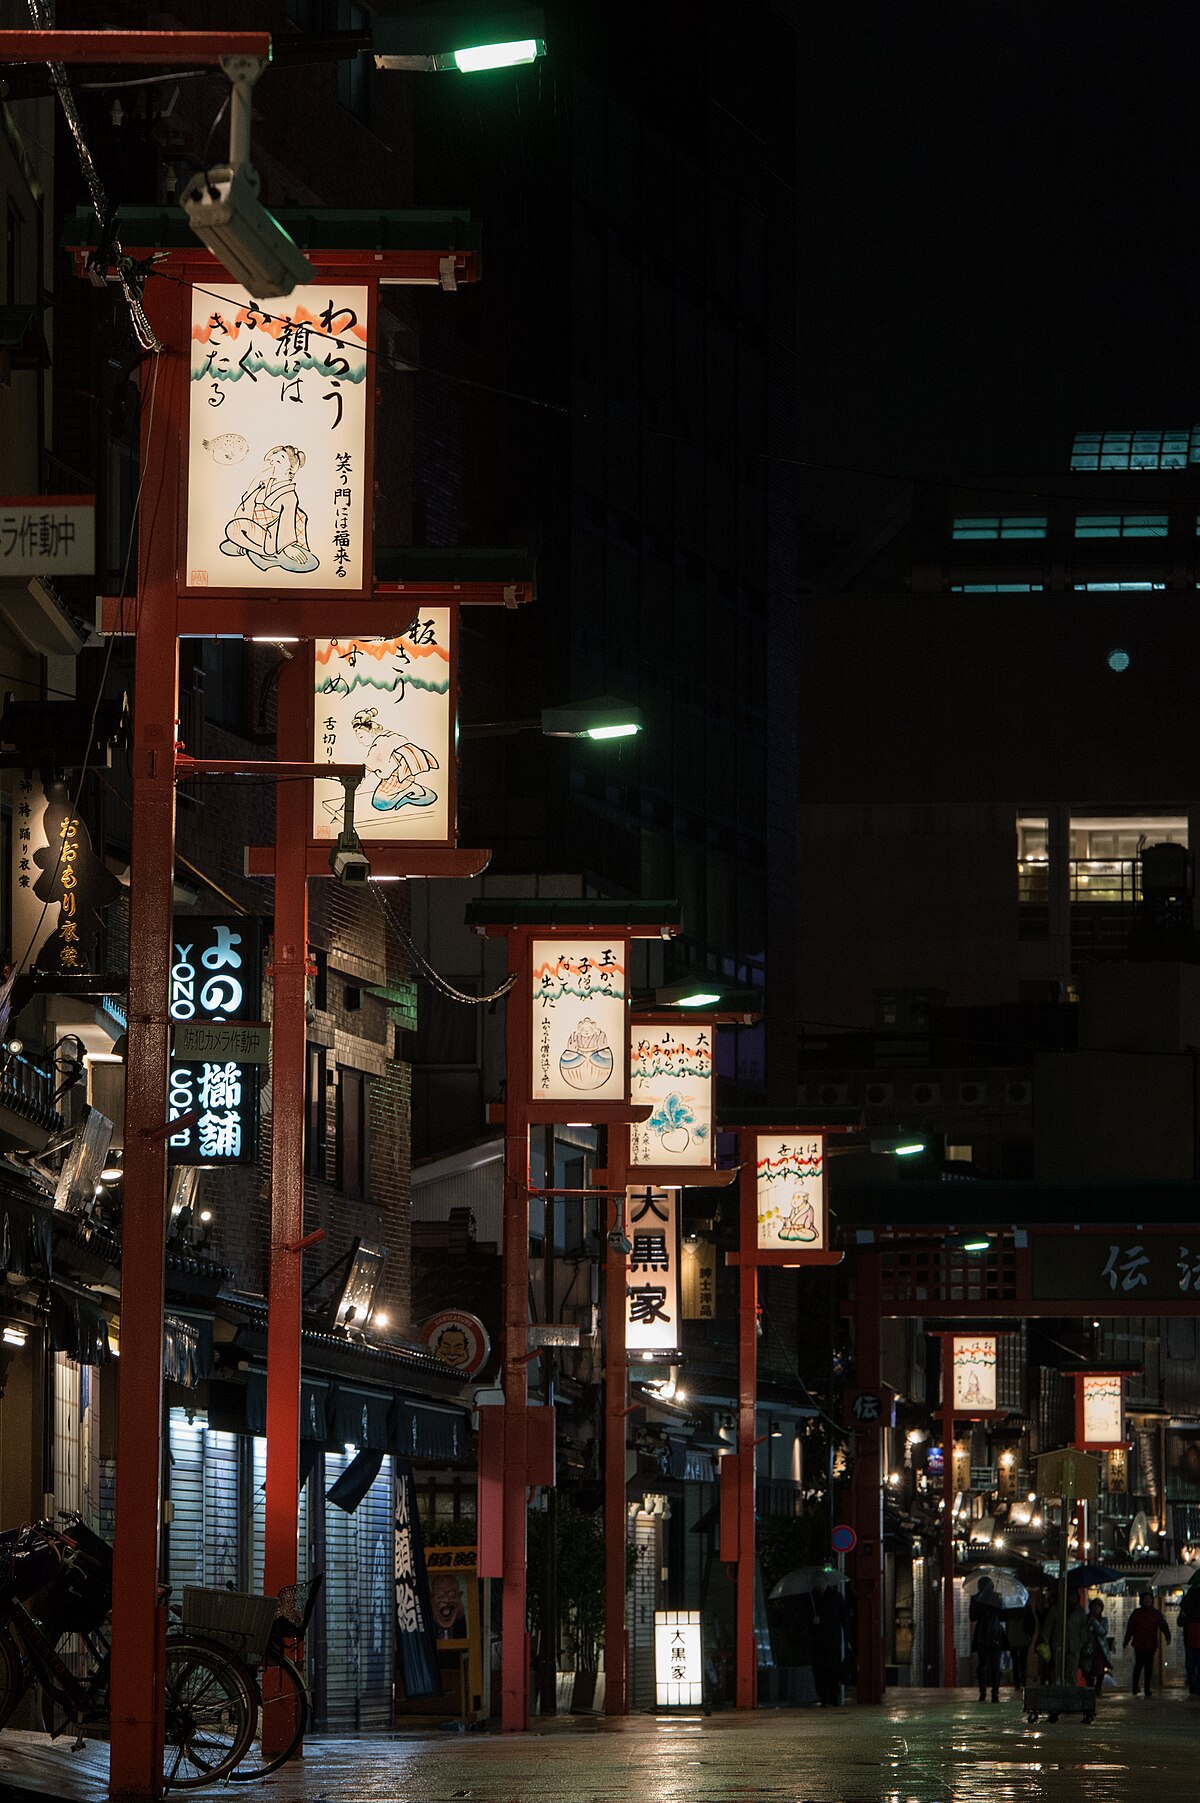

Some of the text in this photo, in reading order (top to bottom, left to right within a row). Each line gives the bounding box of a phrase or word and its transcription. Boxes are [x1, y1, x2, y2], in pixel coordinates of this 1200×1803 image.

[205, 312, 230, 408] きたる
[235, 299, 273, 383] ふぐ
[275, 316, 314, 404] 顔には
[319, 299, 358, 430] わらう
[0, 514, 75, 557] ラ作動中
[332, 451, 353, 578] 笑う門には福来る
[322, 716, 338, 765] 舌切り
[183, 1029, 260, 1054] 防犯カメラ作動中
[197, 925, 243, 1157] よの櫛舗
[629, 1187, 671, 1324] 大黒家
[699, 1267, 712, 1317] 紳士洋品
[671, 1629, 687, 1680] 大黒家
